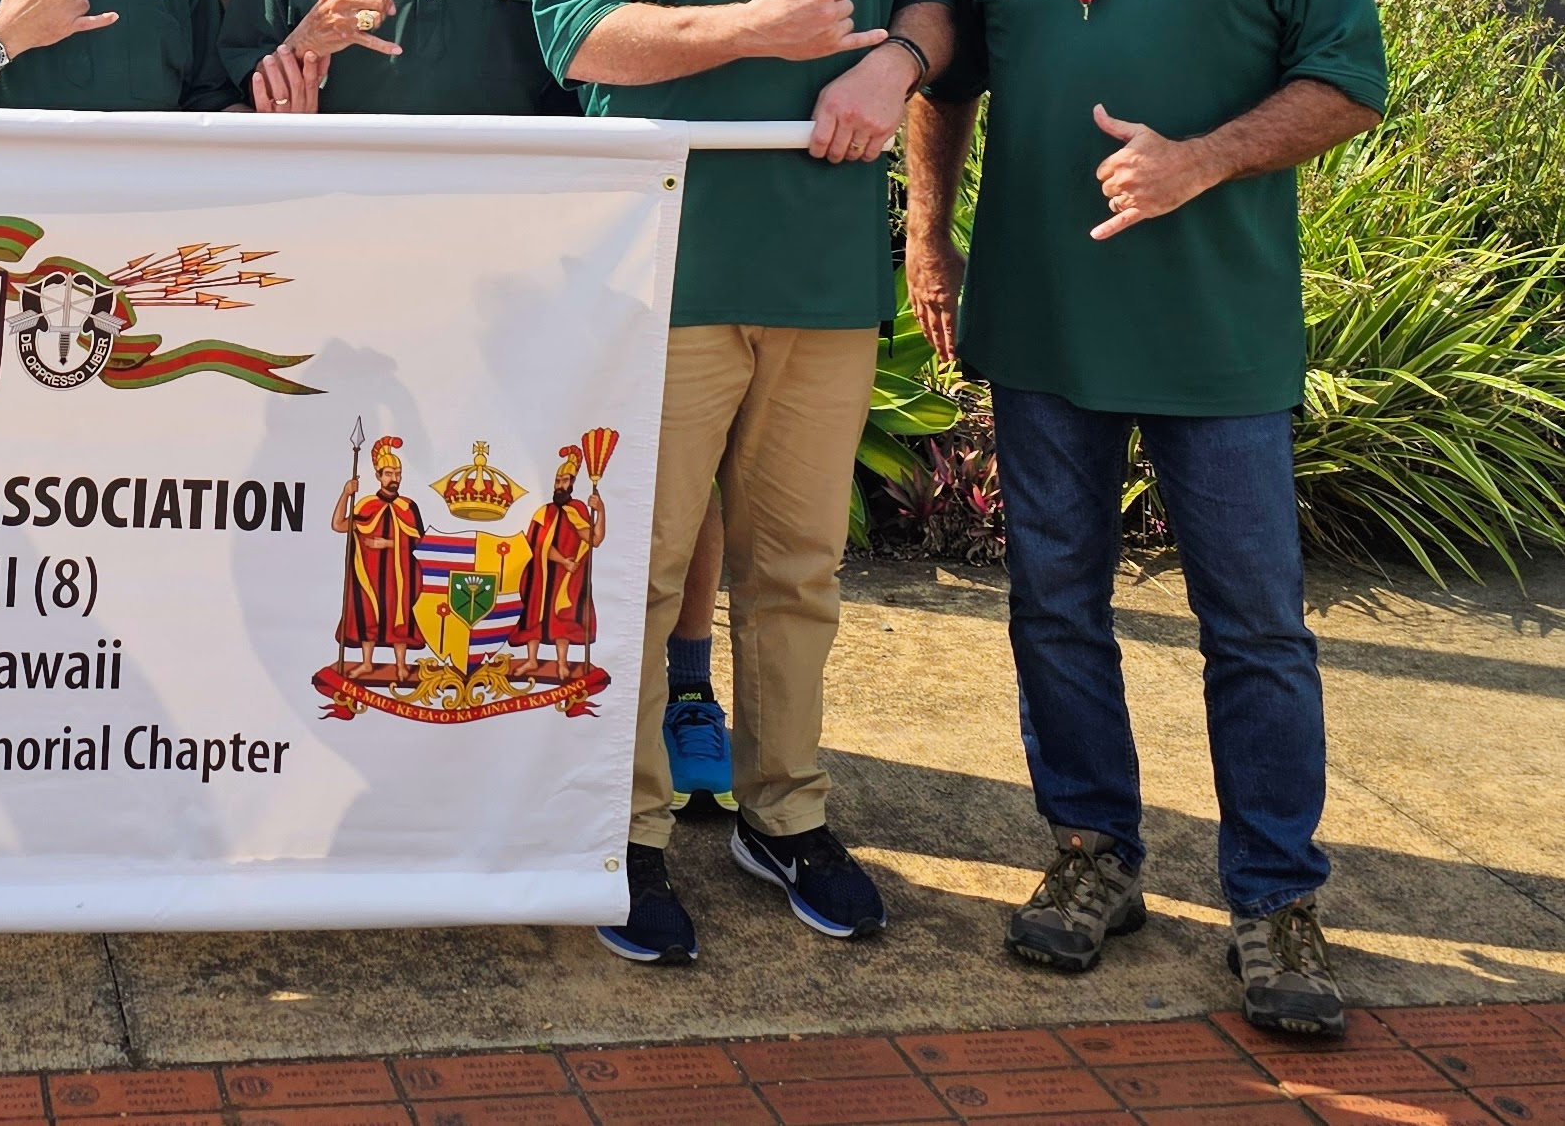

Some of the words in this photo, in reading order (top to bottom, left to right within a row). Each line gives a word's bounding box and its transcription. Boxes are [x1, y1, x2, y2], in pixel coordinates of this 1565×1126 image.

[20, 333, 33, 353] DE
[85, 337, 109, 374] LIBER
[25, 355, 86, 387] OPPRESSO
[34, 555, 98, 618] (8)
[341, 681, 358, 698] UA
[362, 691, 391, 710] MAU
[395, 703, 414, 717] KE
[417, 709, 434, 721] EA
[439, 712, 450, 722] O
[456, 710, 473, 722] KA
[479, 702, 509, 717] AINA
[516, 700, 523, 710] I
[528, 694, 548, 708] KA
[551, 679, 587, 701] PONO
[124, 724, 290, 784] Chapter
